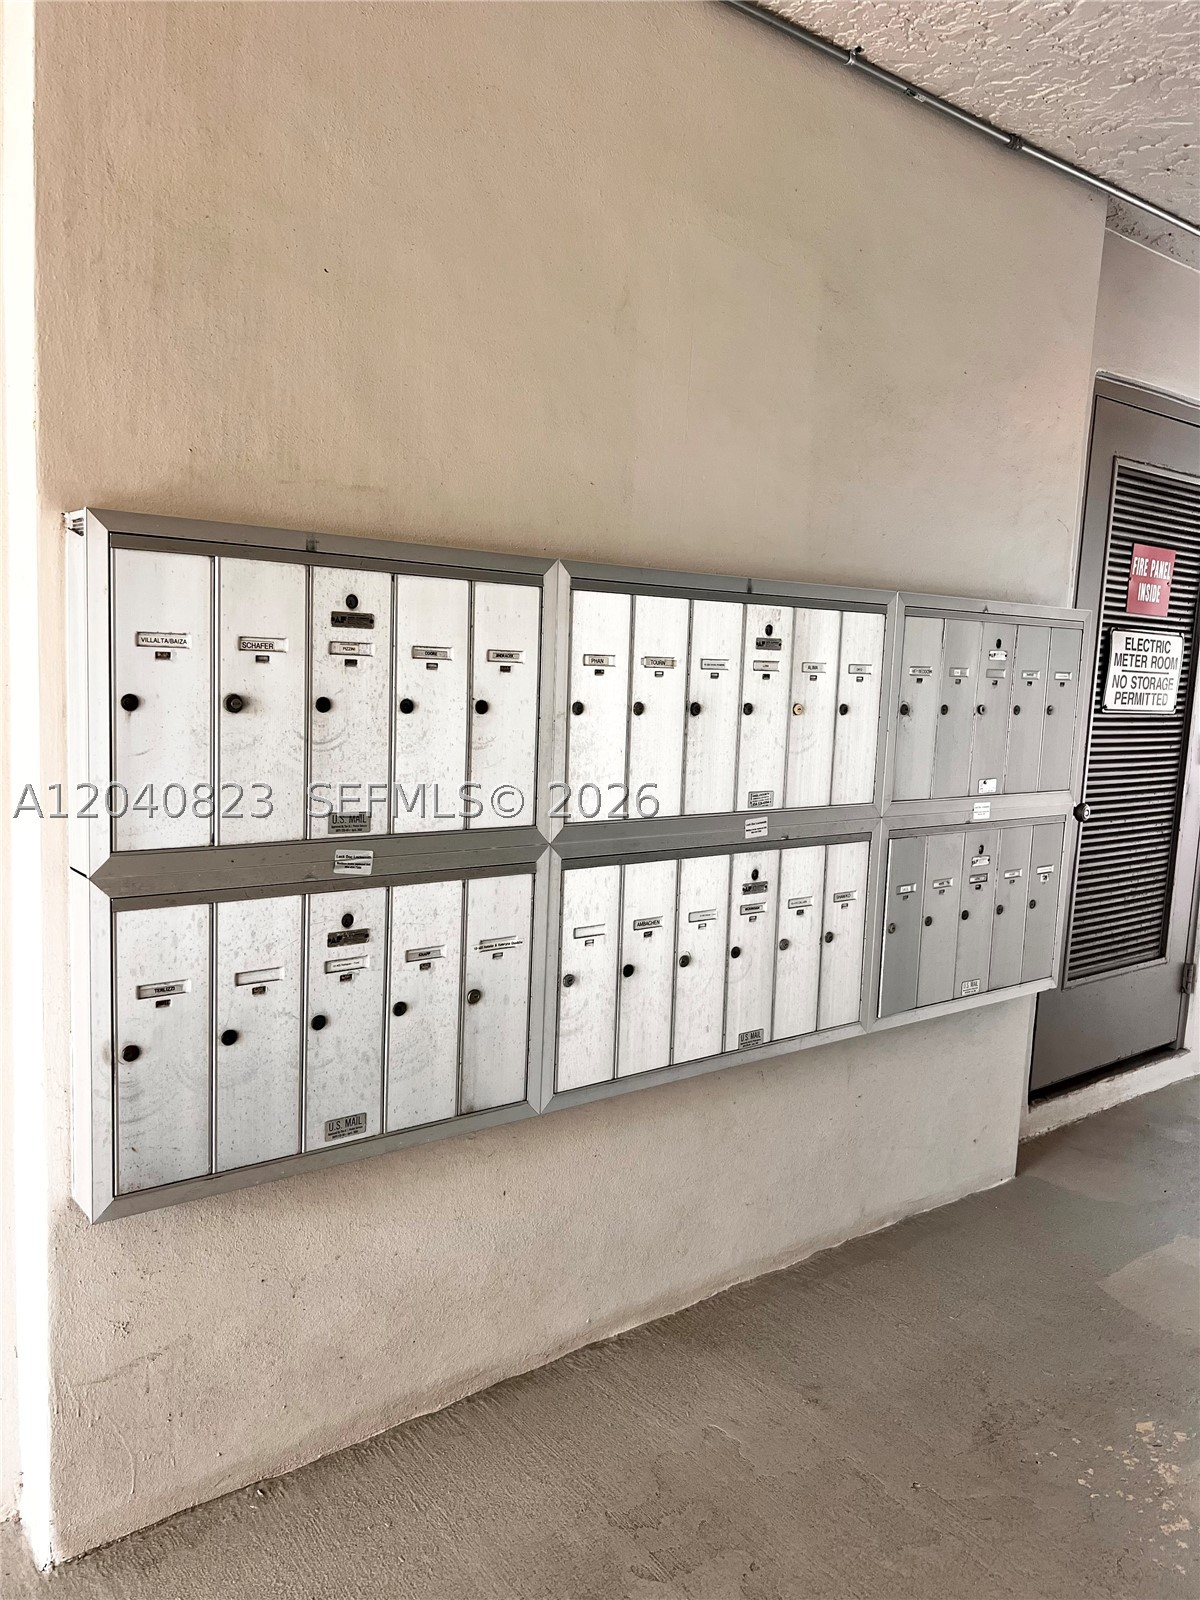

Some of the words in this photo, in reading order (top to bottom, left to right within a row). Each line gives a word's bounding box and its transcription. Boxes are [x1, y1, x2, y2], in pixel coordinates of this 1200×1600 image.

[1132, 557, 1148, 577] FIRE
[1150, 559, 1171, 580] PANEL
[1137, 582, 1162, 603] INSIDE
[140, 636, 188, 645] VILLALTA/BAIZA
[241, 641, 275, 650] SCHAFER
[1125, 636, 1172, 654] ELECTRIC
[1113, 652, 1148, 668] METER
[1150, 656, 1179, 671] ROOM
[1111, 674, 1128, 689] NO
[1130, 676, 1174, 691] STORAGE
[1113, 691, 1169, 706] PERMITTED
[348, 812, 367, 824] MAIL
[328, 1120, 343, 1131] U.S.
[344, 1116, 363, 1128] MAIL
